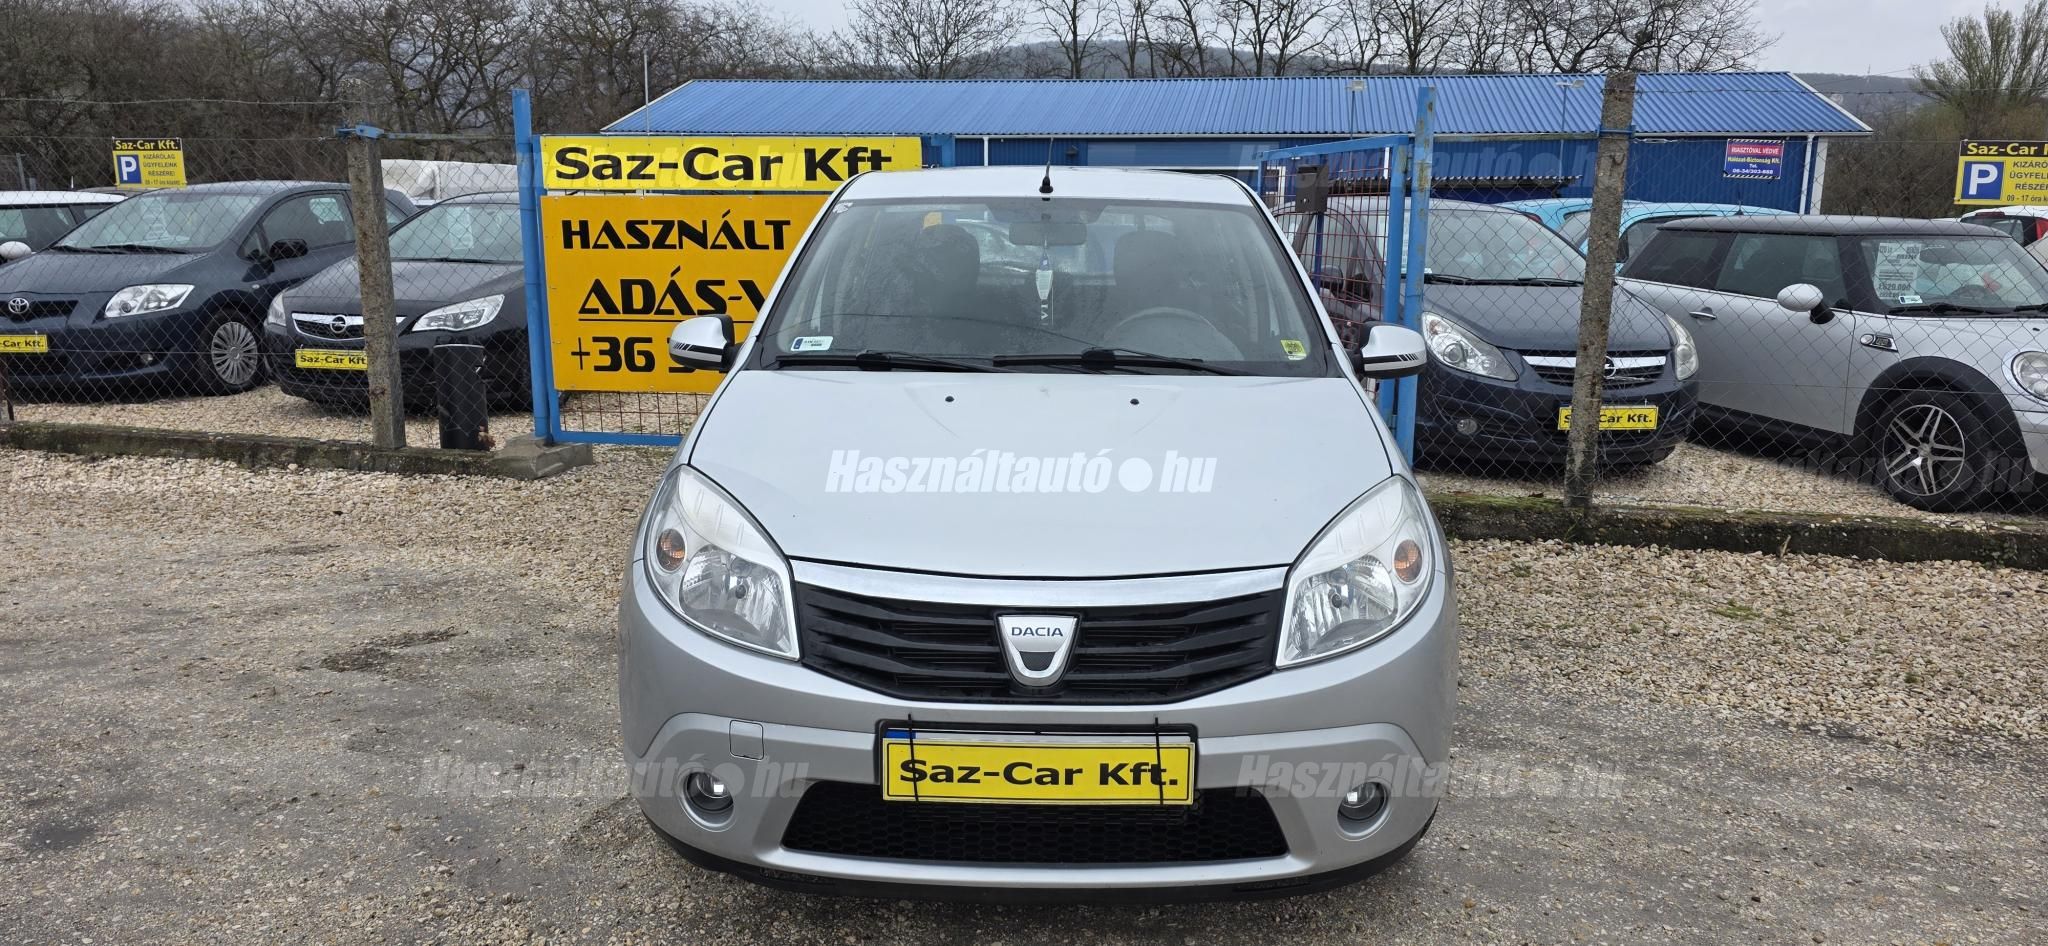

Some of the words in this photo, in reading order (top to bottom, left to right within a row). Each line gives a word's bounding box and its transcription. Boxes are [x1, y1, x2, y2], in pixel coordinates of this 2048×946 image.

[115, 140, 155, 150] Saz-Car
[158, 140, 178, 150] Kft.
[1966, 142, 2039, 156] Saz-Car
[120, 156, 137, 181] P
[555, 146, 784, 182] Saz-Car
[1968, 163, 1998, 195] P
[2009, 170, 2048, 180] ÜGYFEL
[2021, 194, 2029, 202] 17
[561, 209, 792, 250] HASZNÁLT
[300, 354, 345, 364] Saz-Car
[570, 336, 656, 373] +36
[1627, 413, 1653, 423] Kft.
[1011, 626, 1064, 638] DACIA
[899, 759, 1083, 786] Saz-Car
[1099, 762, 1179, 786] Kft.
